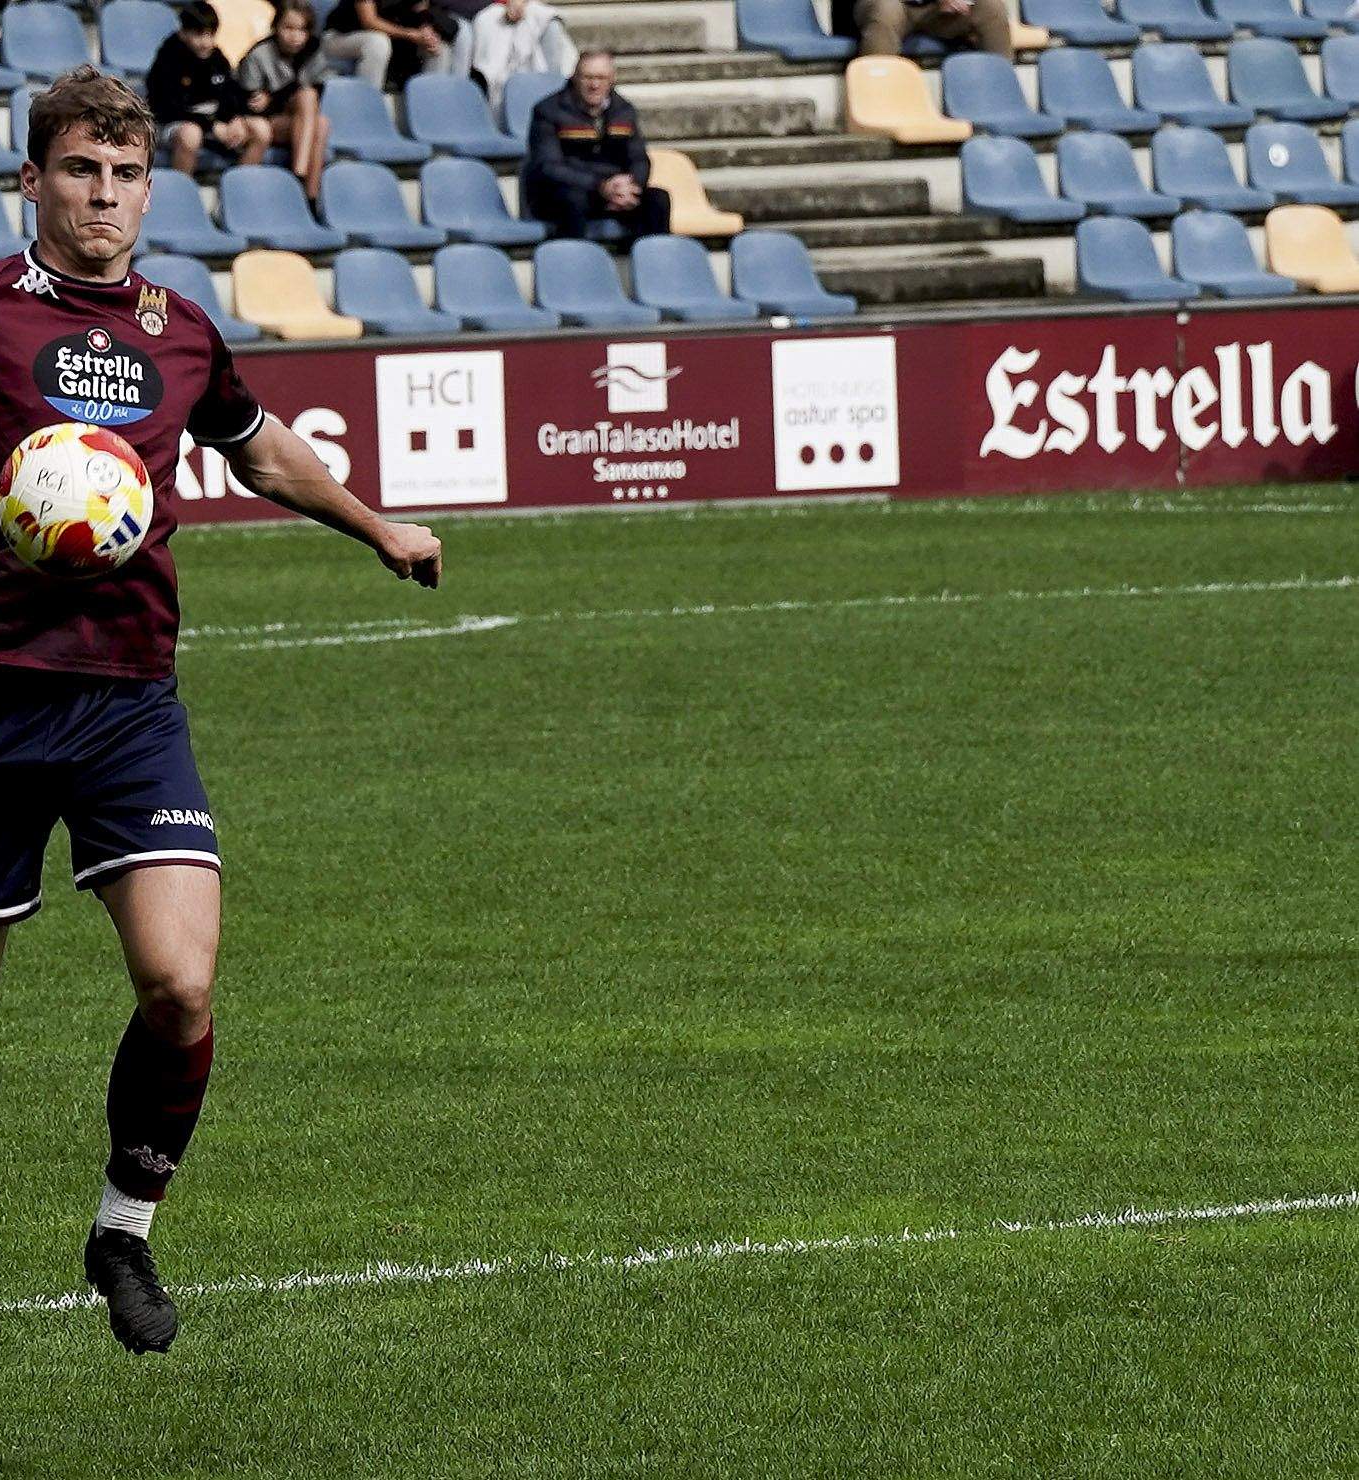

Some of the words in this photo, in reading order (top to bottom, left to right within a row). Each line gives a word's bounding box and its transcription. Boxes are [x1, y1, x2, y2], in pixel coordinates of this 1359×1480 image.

[55, 346, 145, 381] Estrella
[58, 370, 140, 404] Galicia
[407, 368, 475, 407] HCI
[979, 341, 1339, 459] Estrella
[537, 416, 740, 456] GranTalasoHotel
